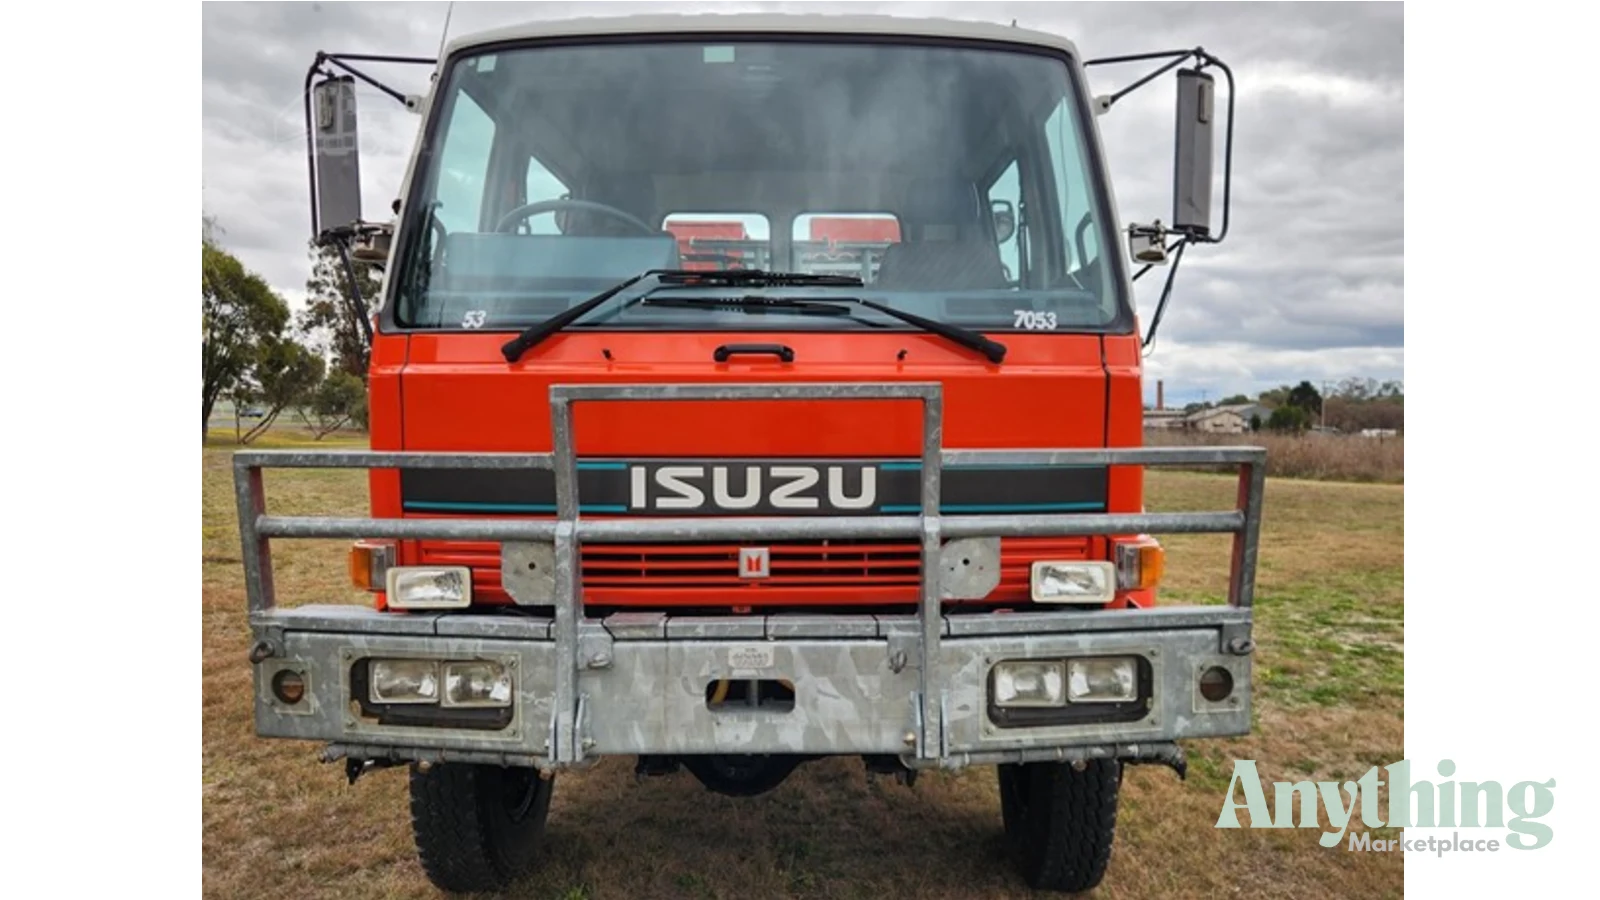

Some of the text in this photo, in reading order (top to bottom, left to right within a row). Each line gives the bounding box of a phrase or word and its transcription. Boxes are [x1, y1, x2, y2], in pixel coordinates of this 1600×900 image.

[462, 310, 486, 329] 53
[1013, 310, 1057, 330] 7053
[630, 466, 877, 509] ISUZU
